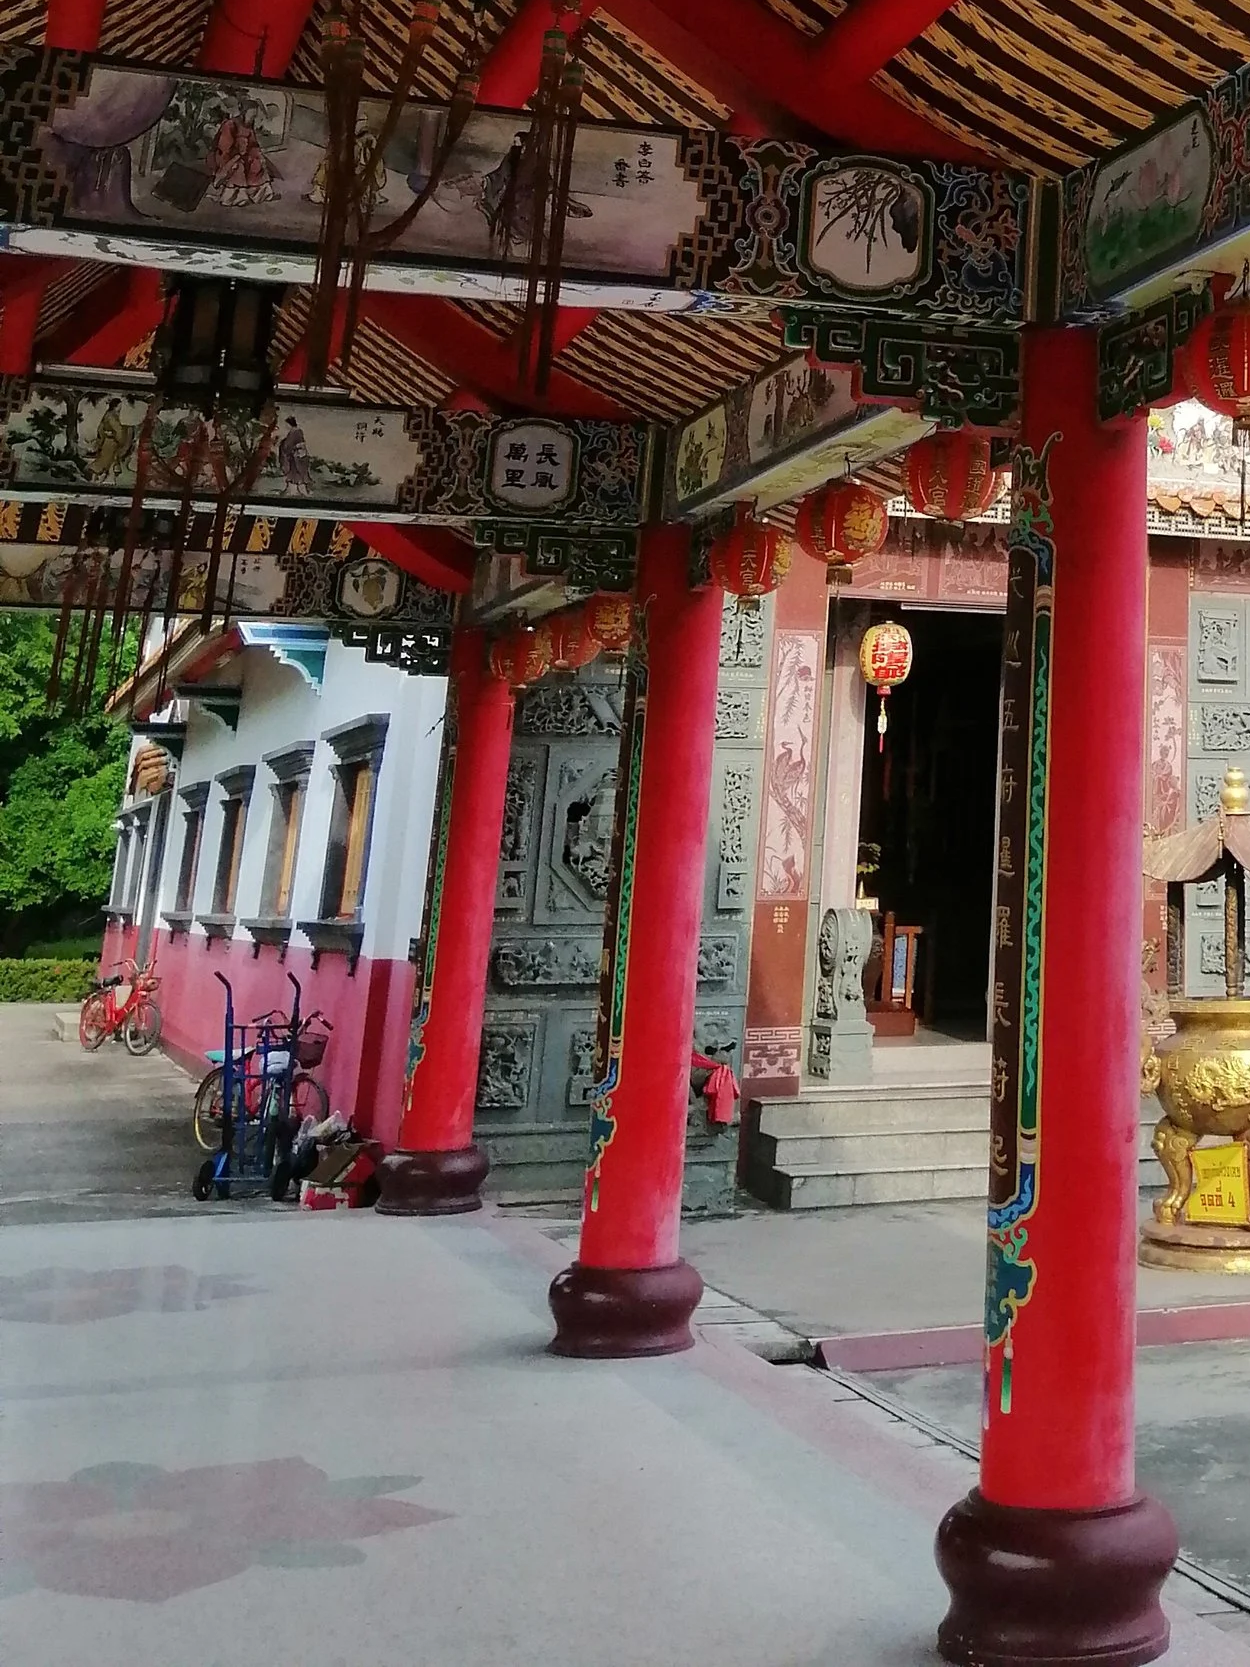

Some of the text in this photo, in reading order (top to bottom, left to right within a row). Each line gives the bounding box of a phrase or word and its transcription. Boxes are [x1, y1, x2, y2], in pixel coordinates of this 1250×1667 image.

[501, 442, 530, 490] 萬里
[534, 443, 562, 492] 長風
[1228, 1191, 1236, 1208] 4
